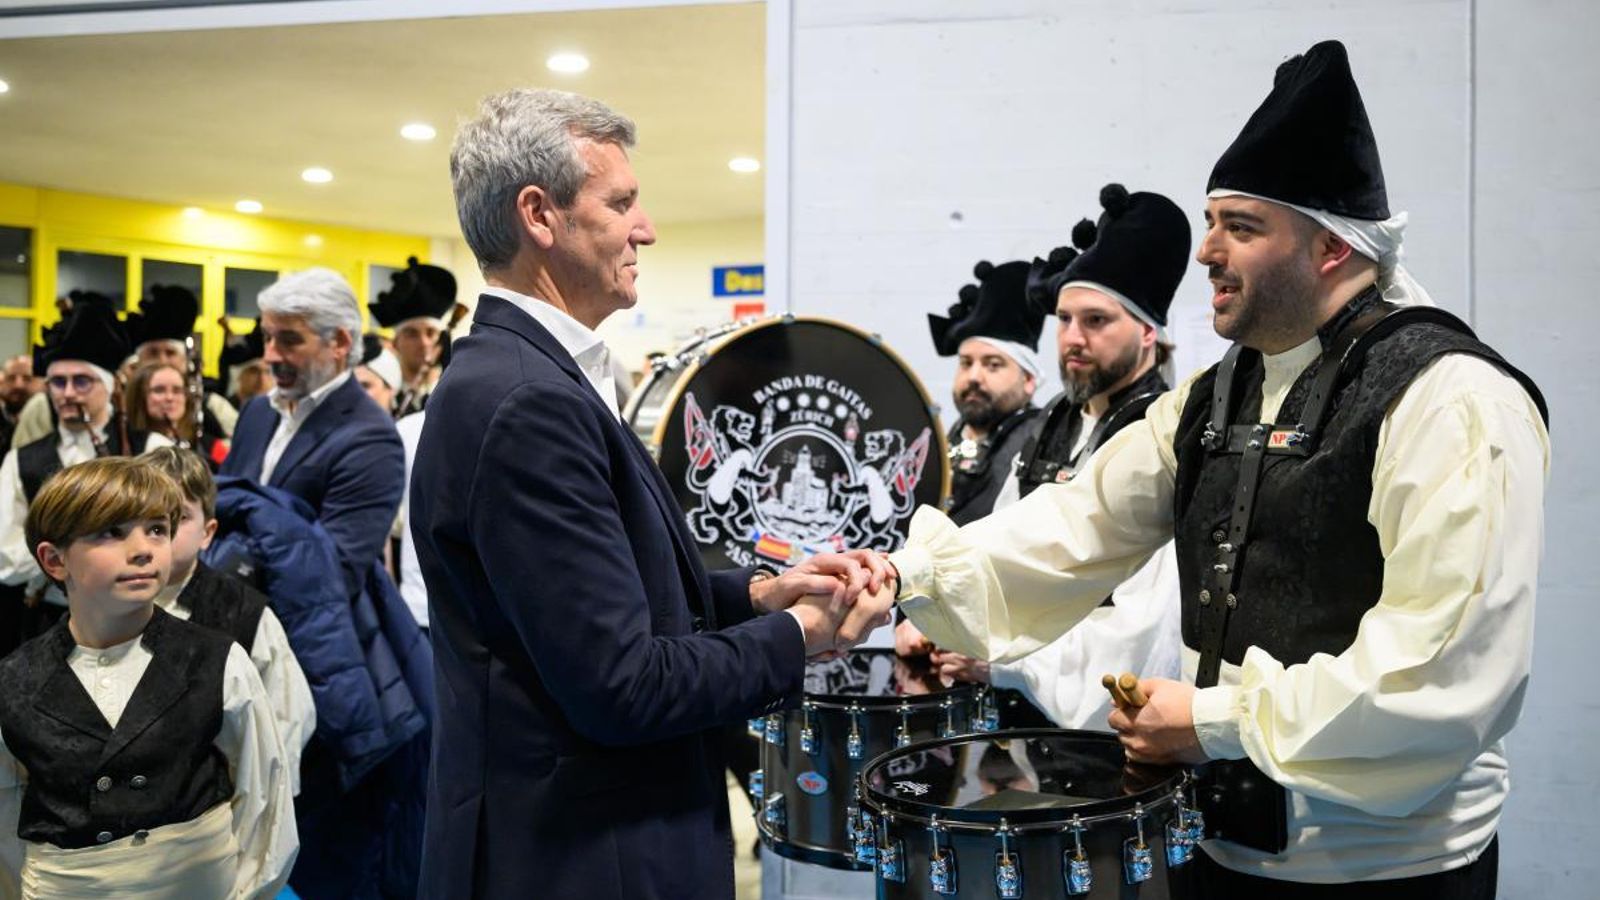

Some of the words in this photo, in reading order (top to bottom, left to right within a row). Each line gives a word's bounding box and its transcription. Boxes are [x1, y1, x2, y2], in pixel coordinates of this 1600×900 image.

[752, 375, 803, 405] BANDA
[804, 374, 826, 390] DE
[826, 379, 873, 421] GAITAS
